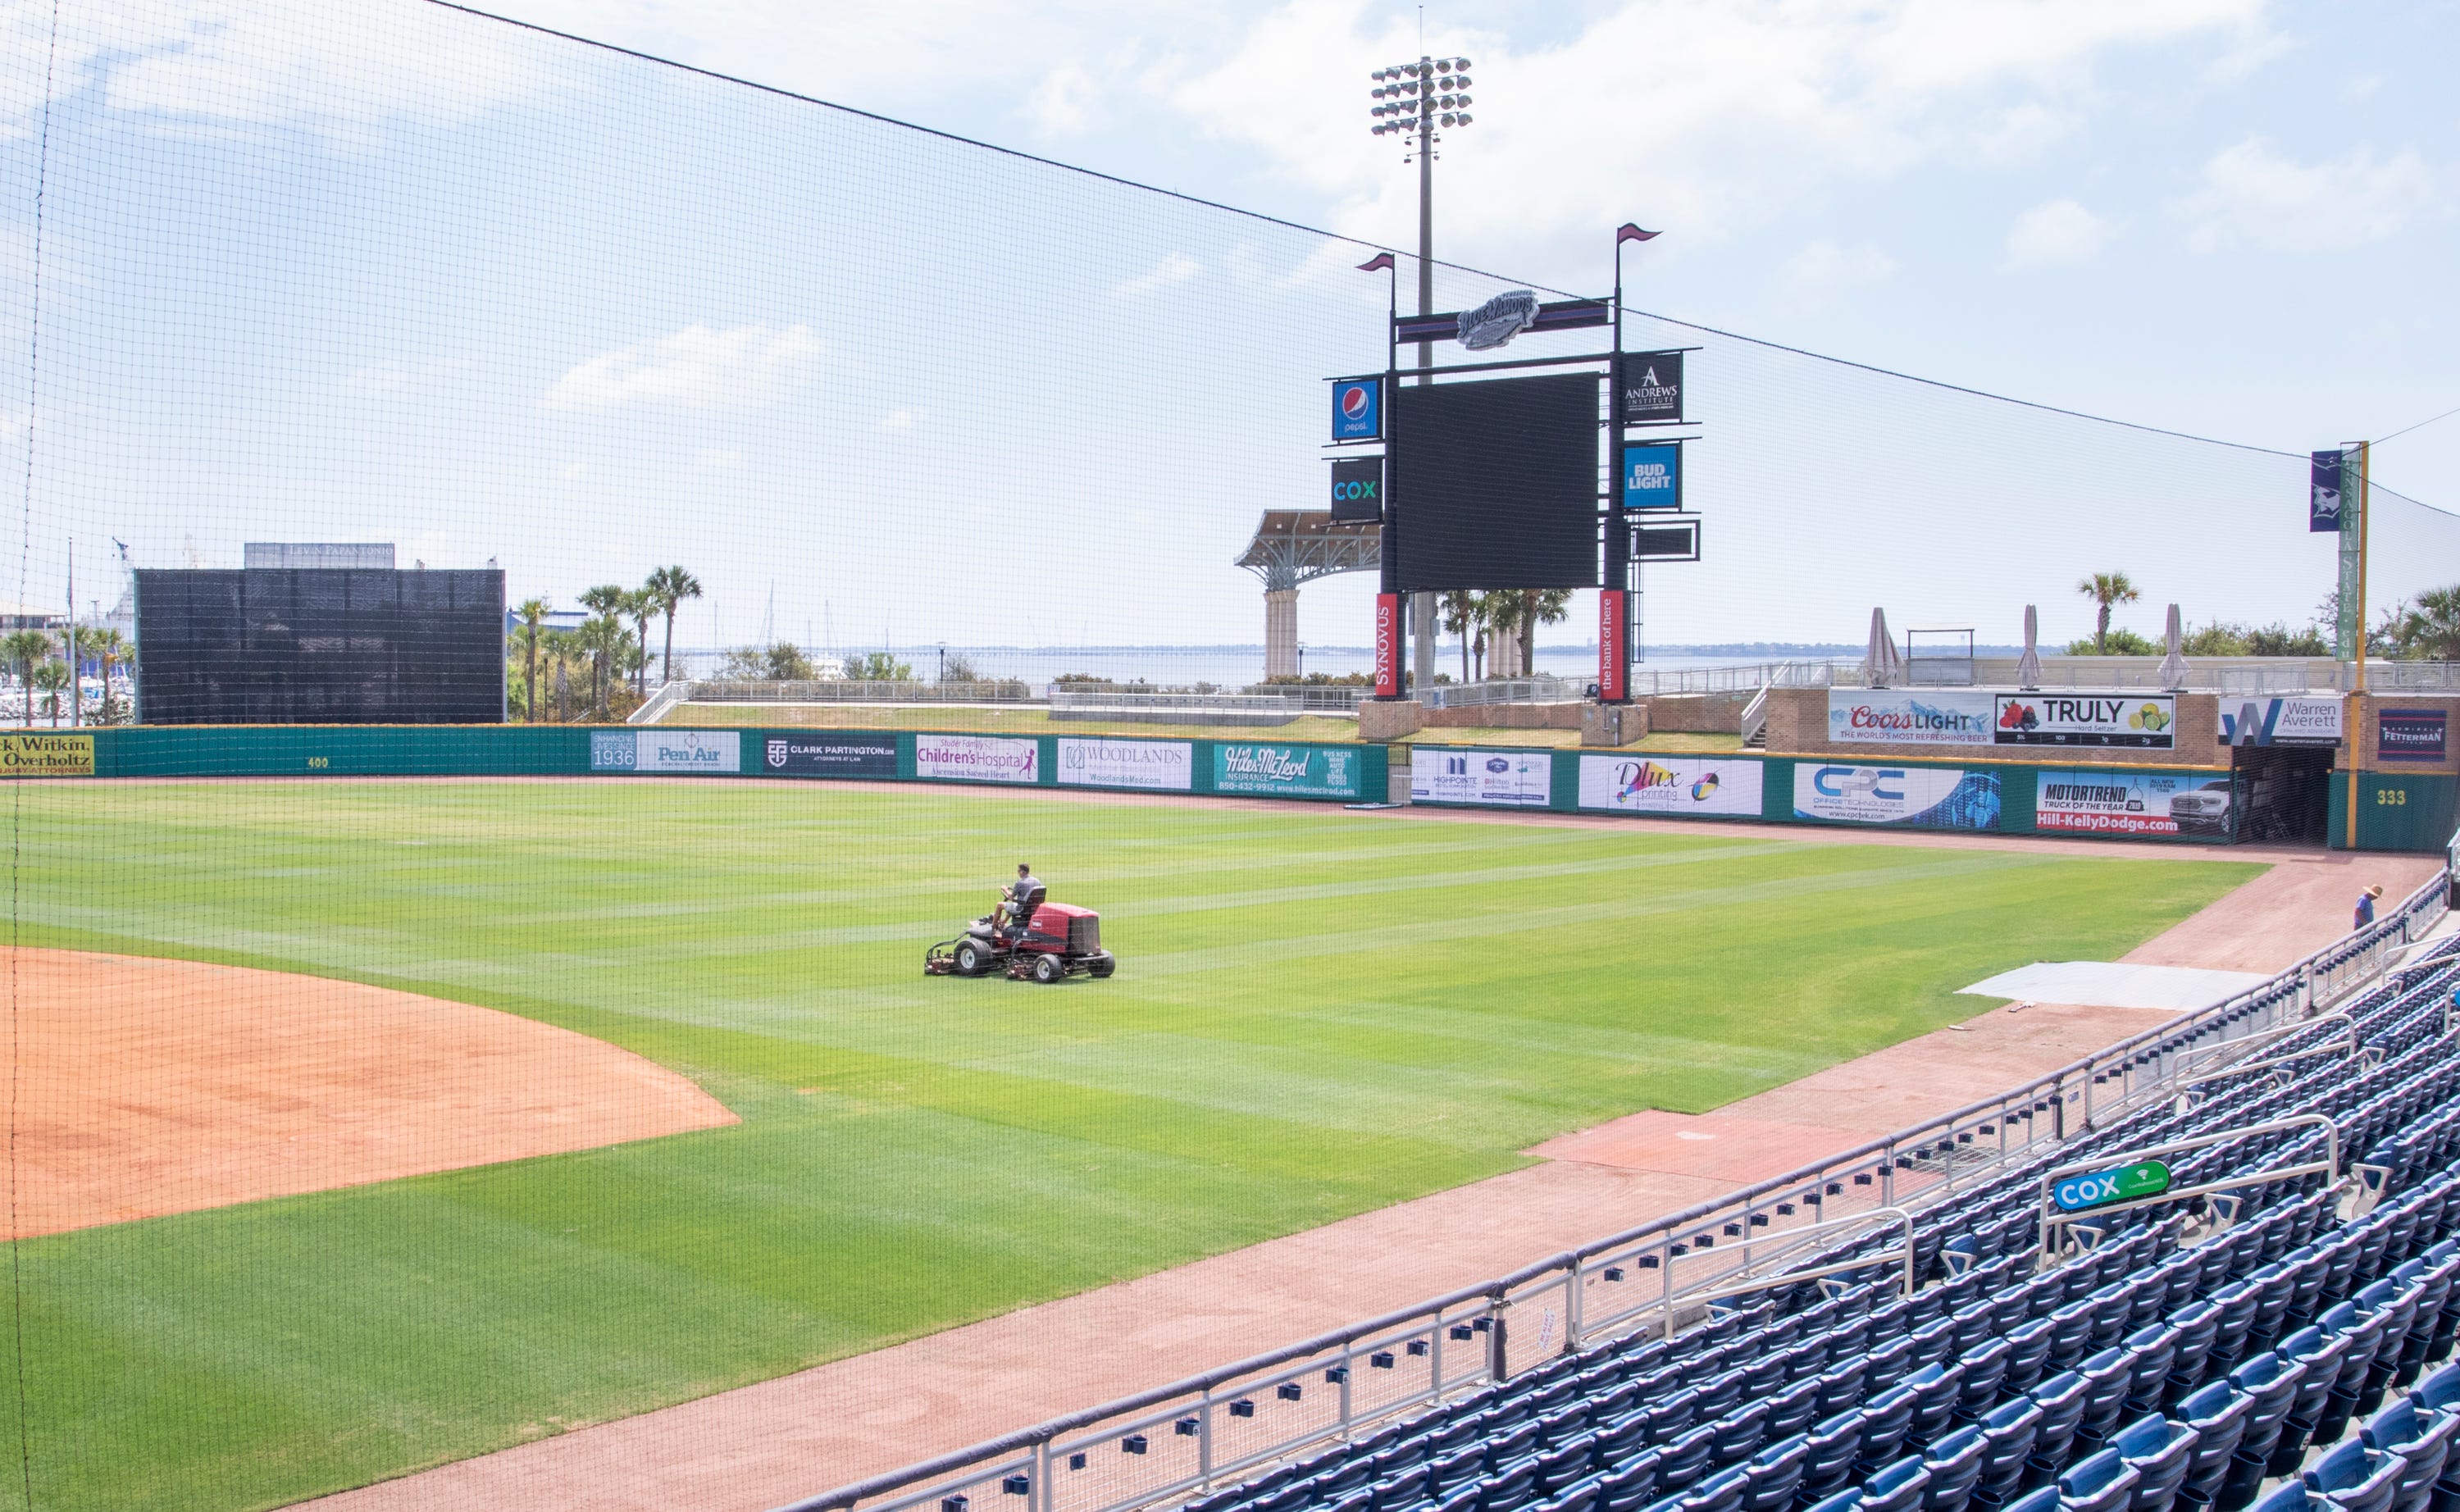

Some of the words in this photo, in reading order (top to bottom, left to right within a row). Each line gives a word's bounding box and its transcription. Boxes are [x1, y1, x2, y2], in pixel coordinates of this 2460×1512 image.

[1625, 385, 1677, 399] ANDREWS
[1629, 397, 1673, 405] INSTITUTE
[1345, 421, 1366, 432] pepsi
[1634, 463, 1665, 477] BUD
[1334, 480, 1376, 500] COX
[1629, 476, 1671, 490] LIGHT
[1603, 599, 1611, 625] here
[1603, 626, 1611, 638] of
[1378, 606, 1388, 685] SYNOVUS
[1603, 640, 1611, 669] bank
[1603, 671, 1611, 690] the
[2043, 699, 2125, 723] TRULY
[2287, 702, 2336, 715] Warren
[1851, 705, 1913, 730] Coors
[1915, 714, 1969, 731] LIGHT
[2282, 713, 2335, 727] Averett
[941, 739, 961, 747] Studer
[1856, 731, 1891, 740] WORLD'S
[1916, 734, 1966, 742] REFRESHING
[2385, 731, 2441, 741] FETTERMAN
[21, 737, 89, 752] Witkin,
[790, 745, 822, 754] CLARK
[825, 746, 895, 755] PARTINGTON.com
[4, 753, 90, 766] Overholtz
[594, 749, 635, 765] 1936
[658, 747, 690, 761] Pen
[693, 747, 721, 761] Air
[918, 748, 976, 764] Children's
[977, 752, 1023, 769] Hospital
[1087, 746, 1182, 764] WOODLANDS
[308, 757, 328, 768] 400
[966, 769, 989, 777] Sacred
[991, 770, 1009, 778] Heart
[1090, 773, 1161, 784] WoodlandsMed.com
[1226, 773, 1269, 782] INSURANCE
[1615, 761, 1684, 788] Dlux
[1219, 781, 1274, 791] 850-432-9912
[1814, 767, 1905, 800] CPC
[1642, 790, 1678, 801] printing
[2045, 784, 2126, 802] MOTORTREND
[2378, 790, 2406, 805] 333
[1829, 811, 1885, 820] www.cpctek.com
[2037, 813, 2178, 832] Hill-KellyDodge.com
[2061, 1176, 2120, 1205] COX
